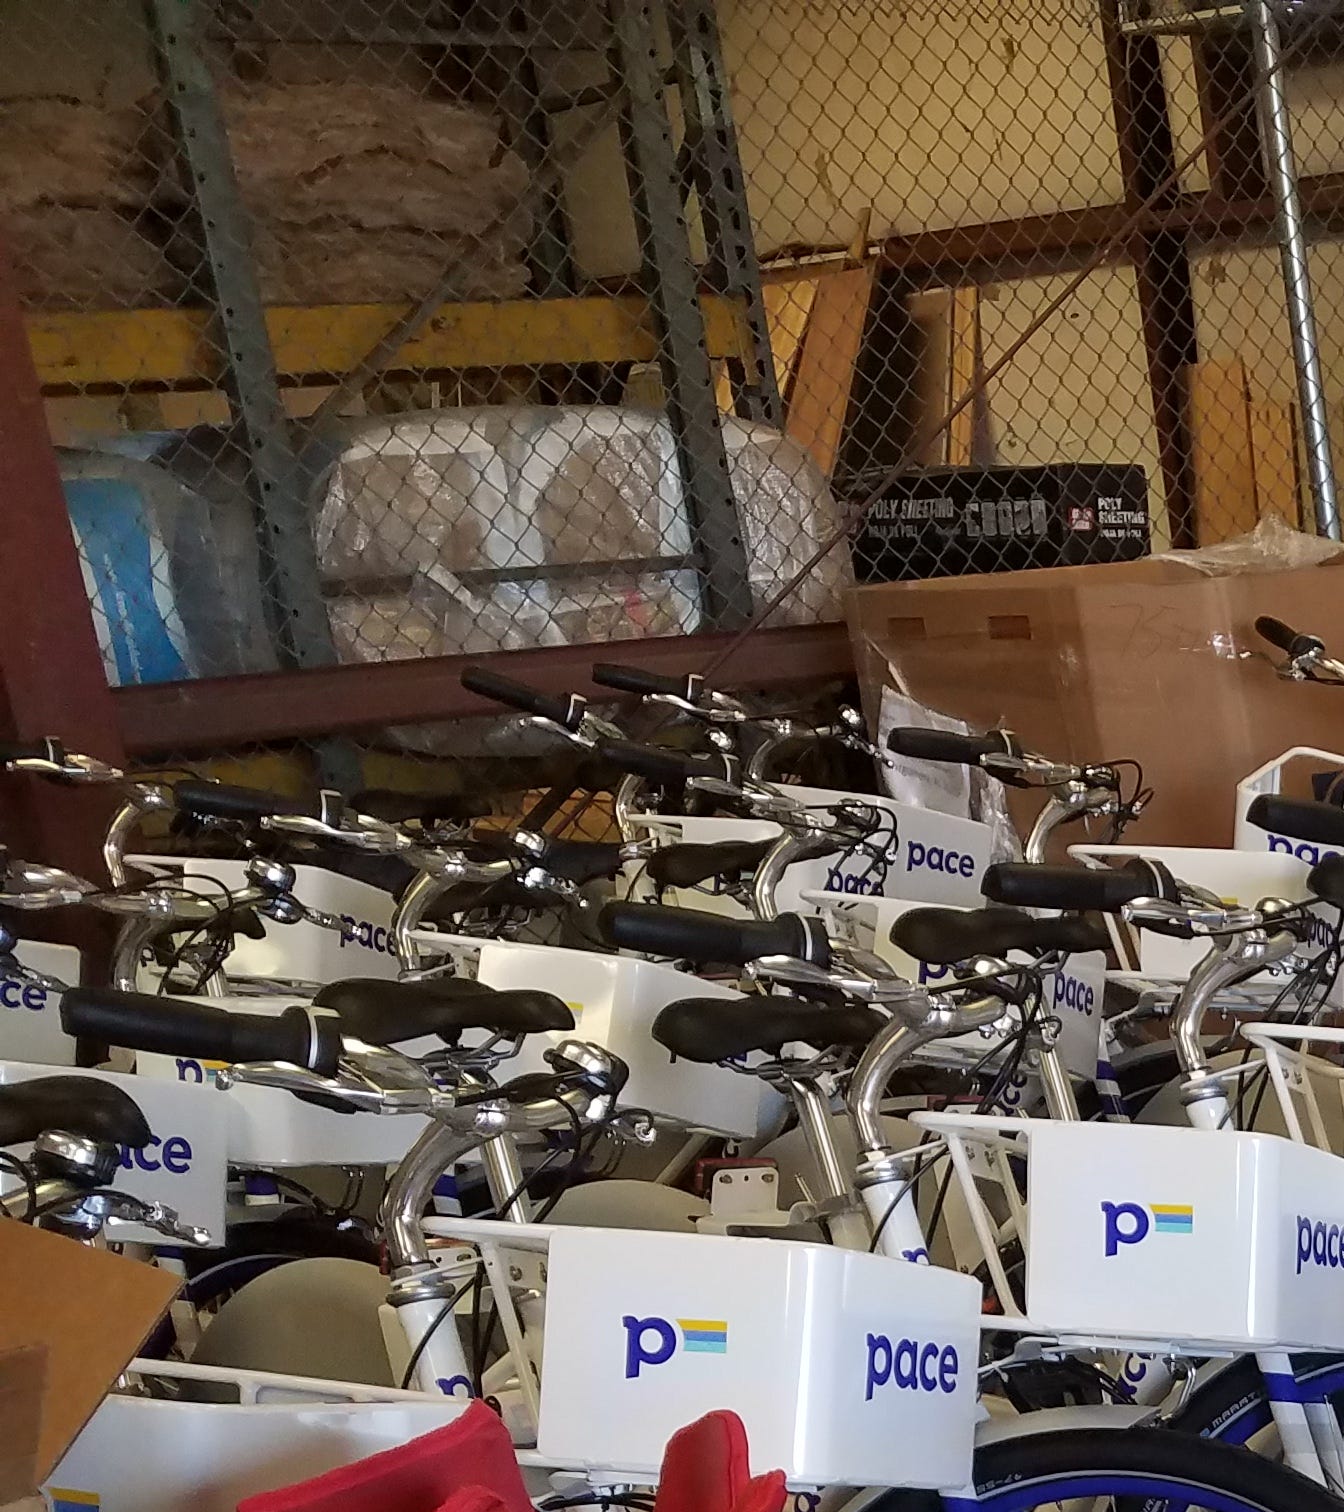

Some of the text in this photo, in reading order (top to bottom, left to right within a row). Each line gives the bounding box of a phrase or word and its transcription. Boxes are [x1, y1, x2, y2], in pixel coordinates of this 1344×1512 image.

[1097, 498, 1122, 511] POLY
[1099, 511, 1146, 524] SHEETING
[907, 840, 975, 877] pace
[1053, 970, 1094, 1016] pace
[1101, 1200, 1150, 1258] p
[622, 1315, 677, 1379] p
[866, 1332, 958, 1401] pace
